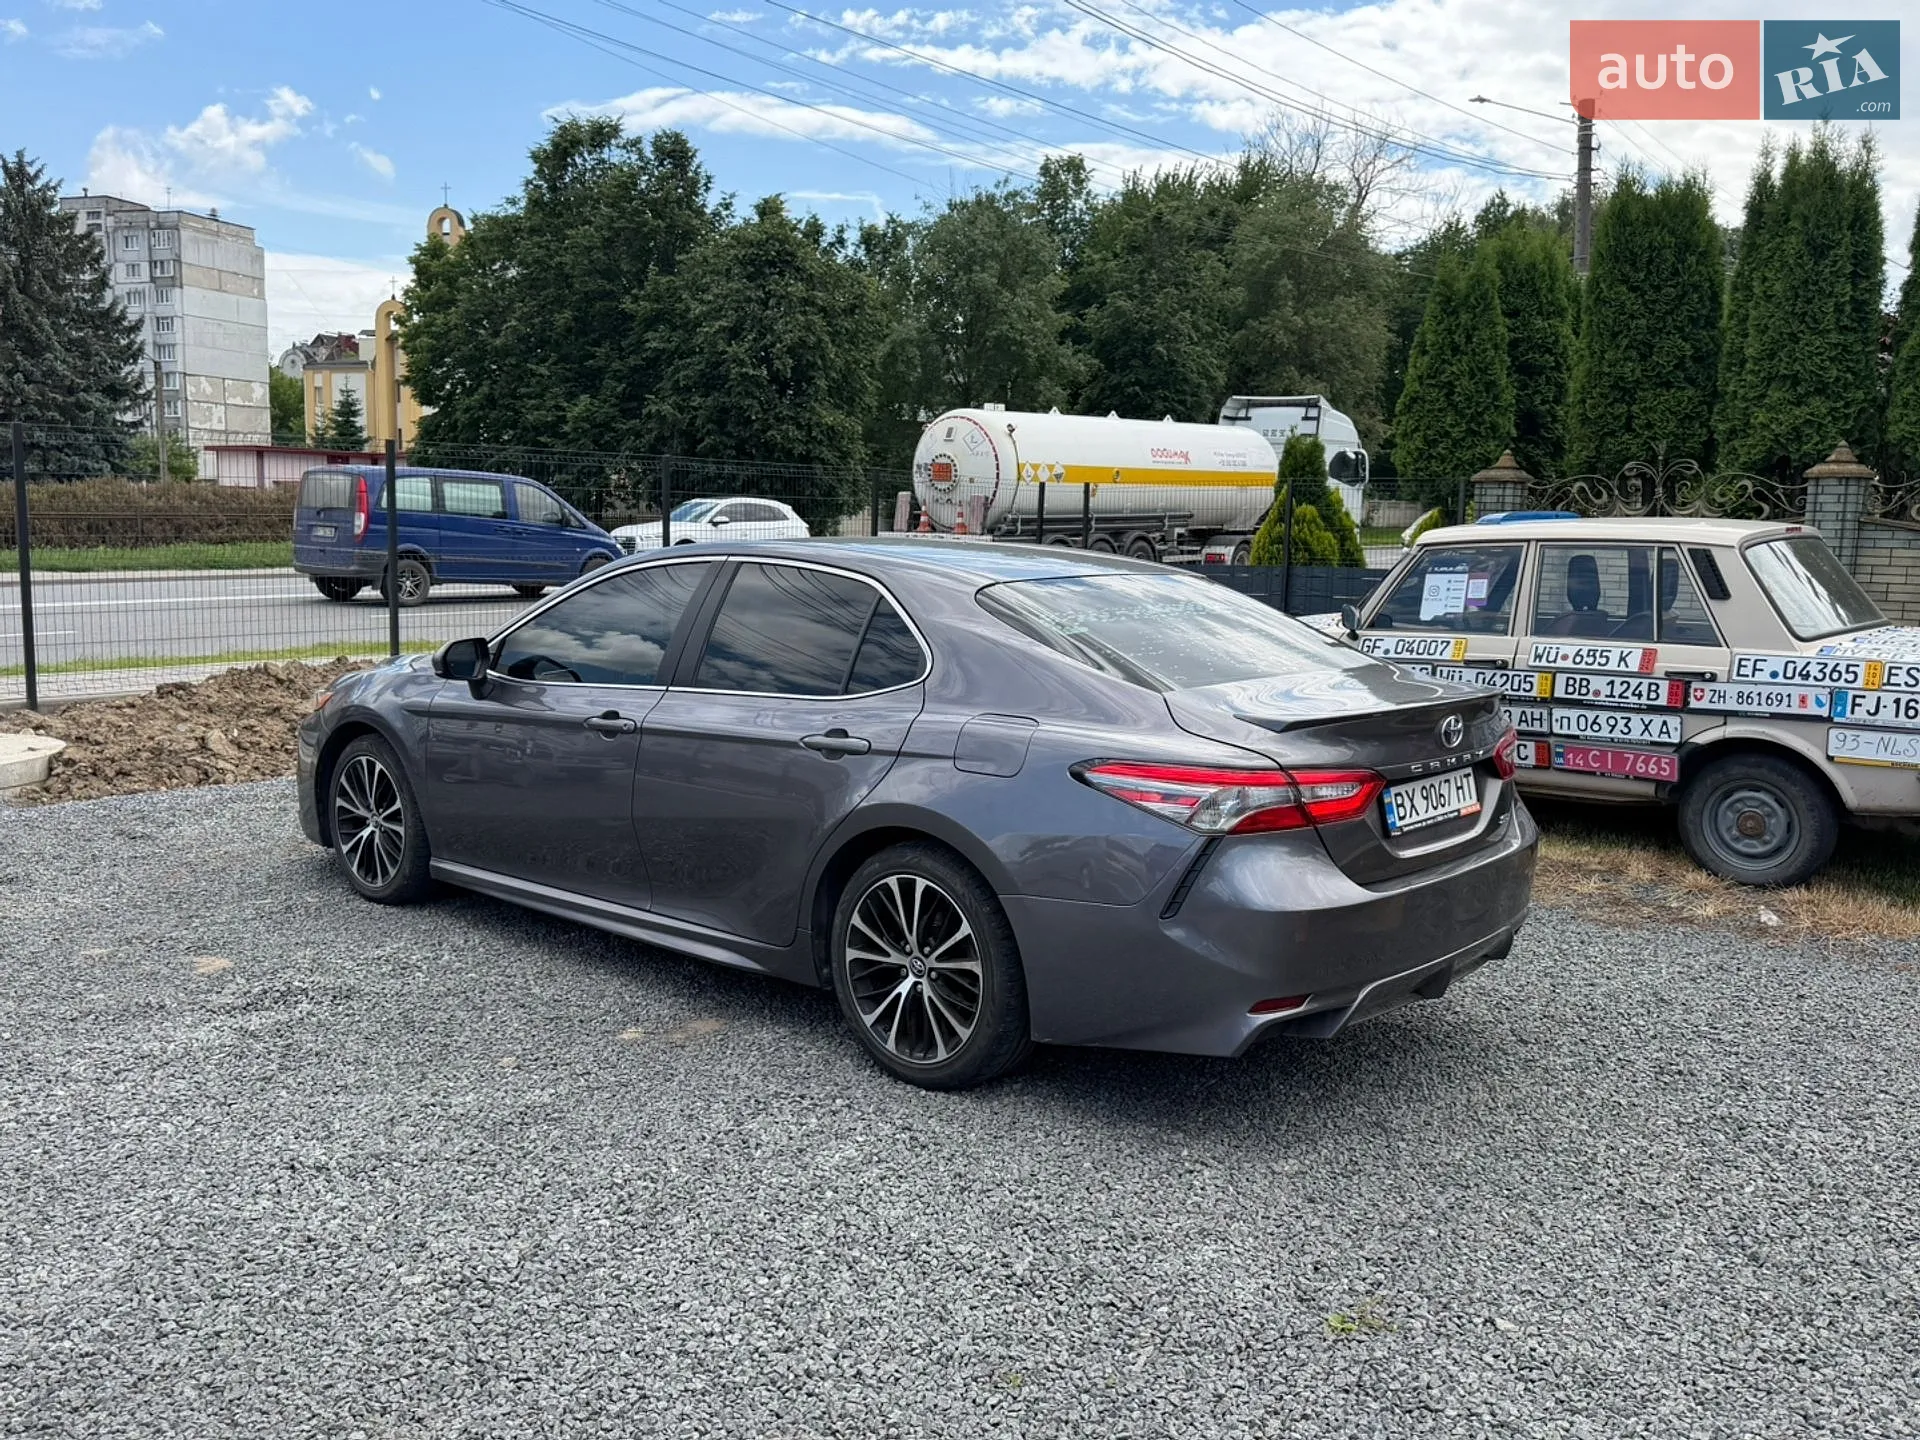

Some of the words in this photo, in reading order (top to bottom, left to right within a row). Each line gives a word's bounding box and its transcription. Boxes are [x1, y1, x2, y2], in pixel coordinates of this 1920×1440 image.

[1394, 639, 1451, 656] 04007
[1617, 650, 1633, 669] K
[1736, 658, 1767, 679] EF
[1783, 660, 1860, 684] 04365
[1887, 665, 1920, 688] ES
[1564, 677, 1591, 697] BB
[1605, 679, 1661, 701] 124B
[1577, 714, 1632, 735] 0693
[1411, 750, 1483, 772] CAMRY
[1623, 753, 1670, 776] 7665
[1394, 787, 1419, 821] BX
[1421, 778, 1451, 814] 9067
[1454, 772, 1472, 804] HT
